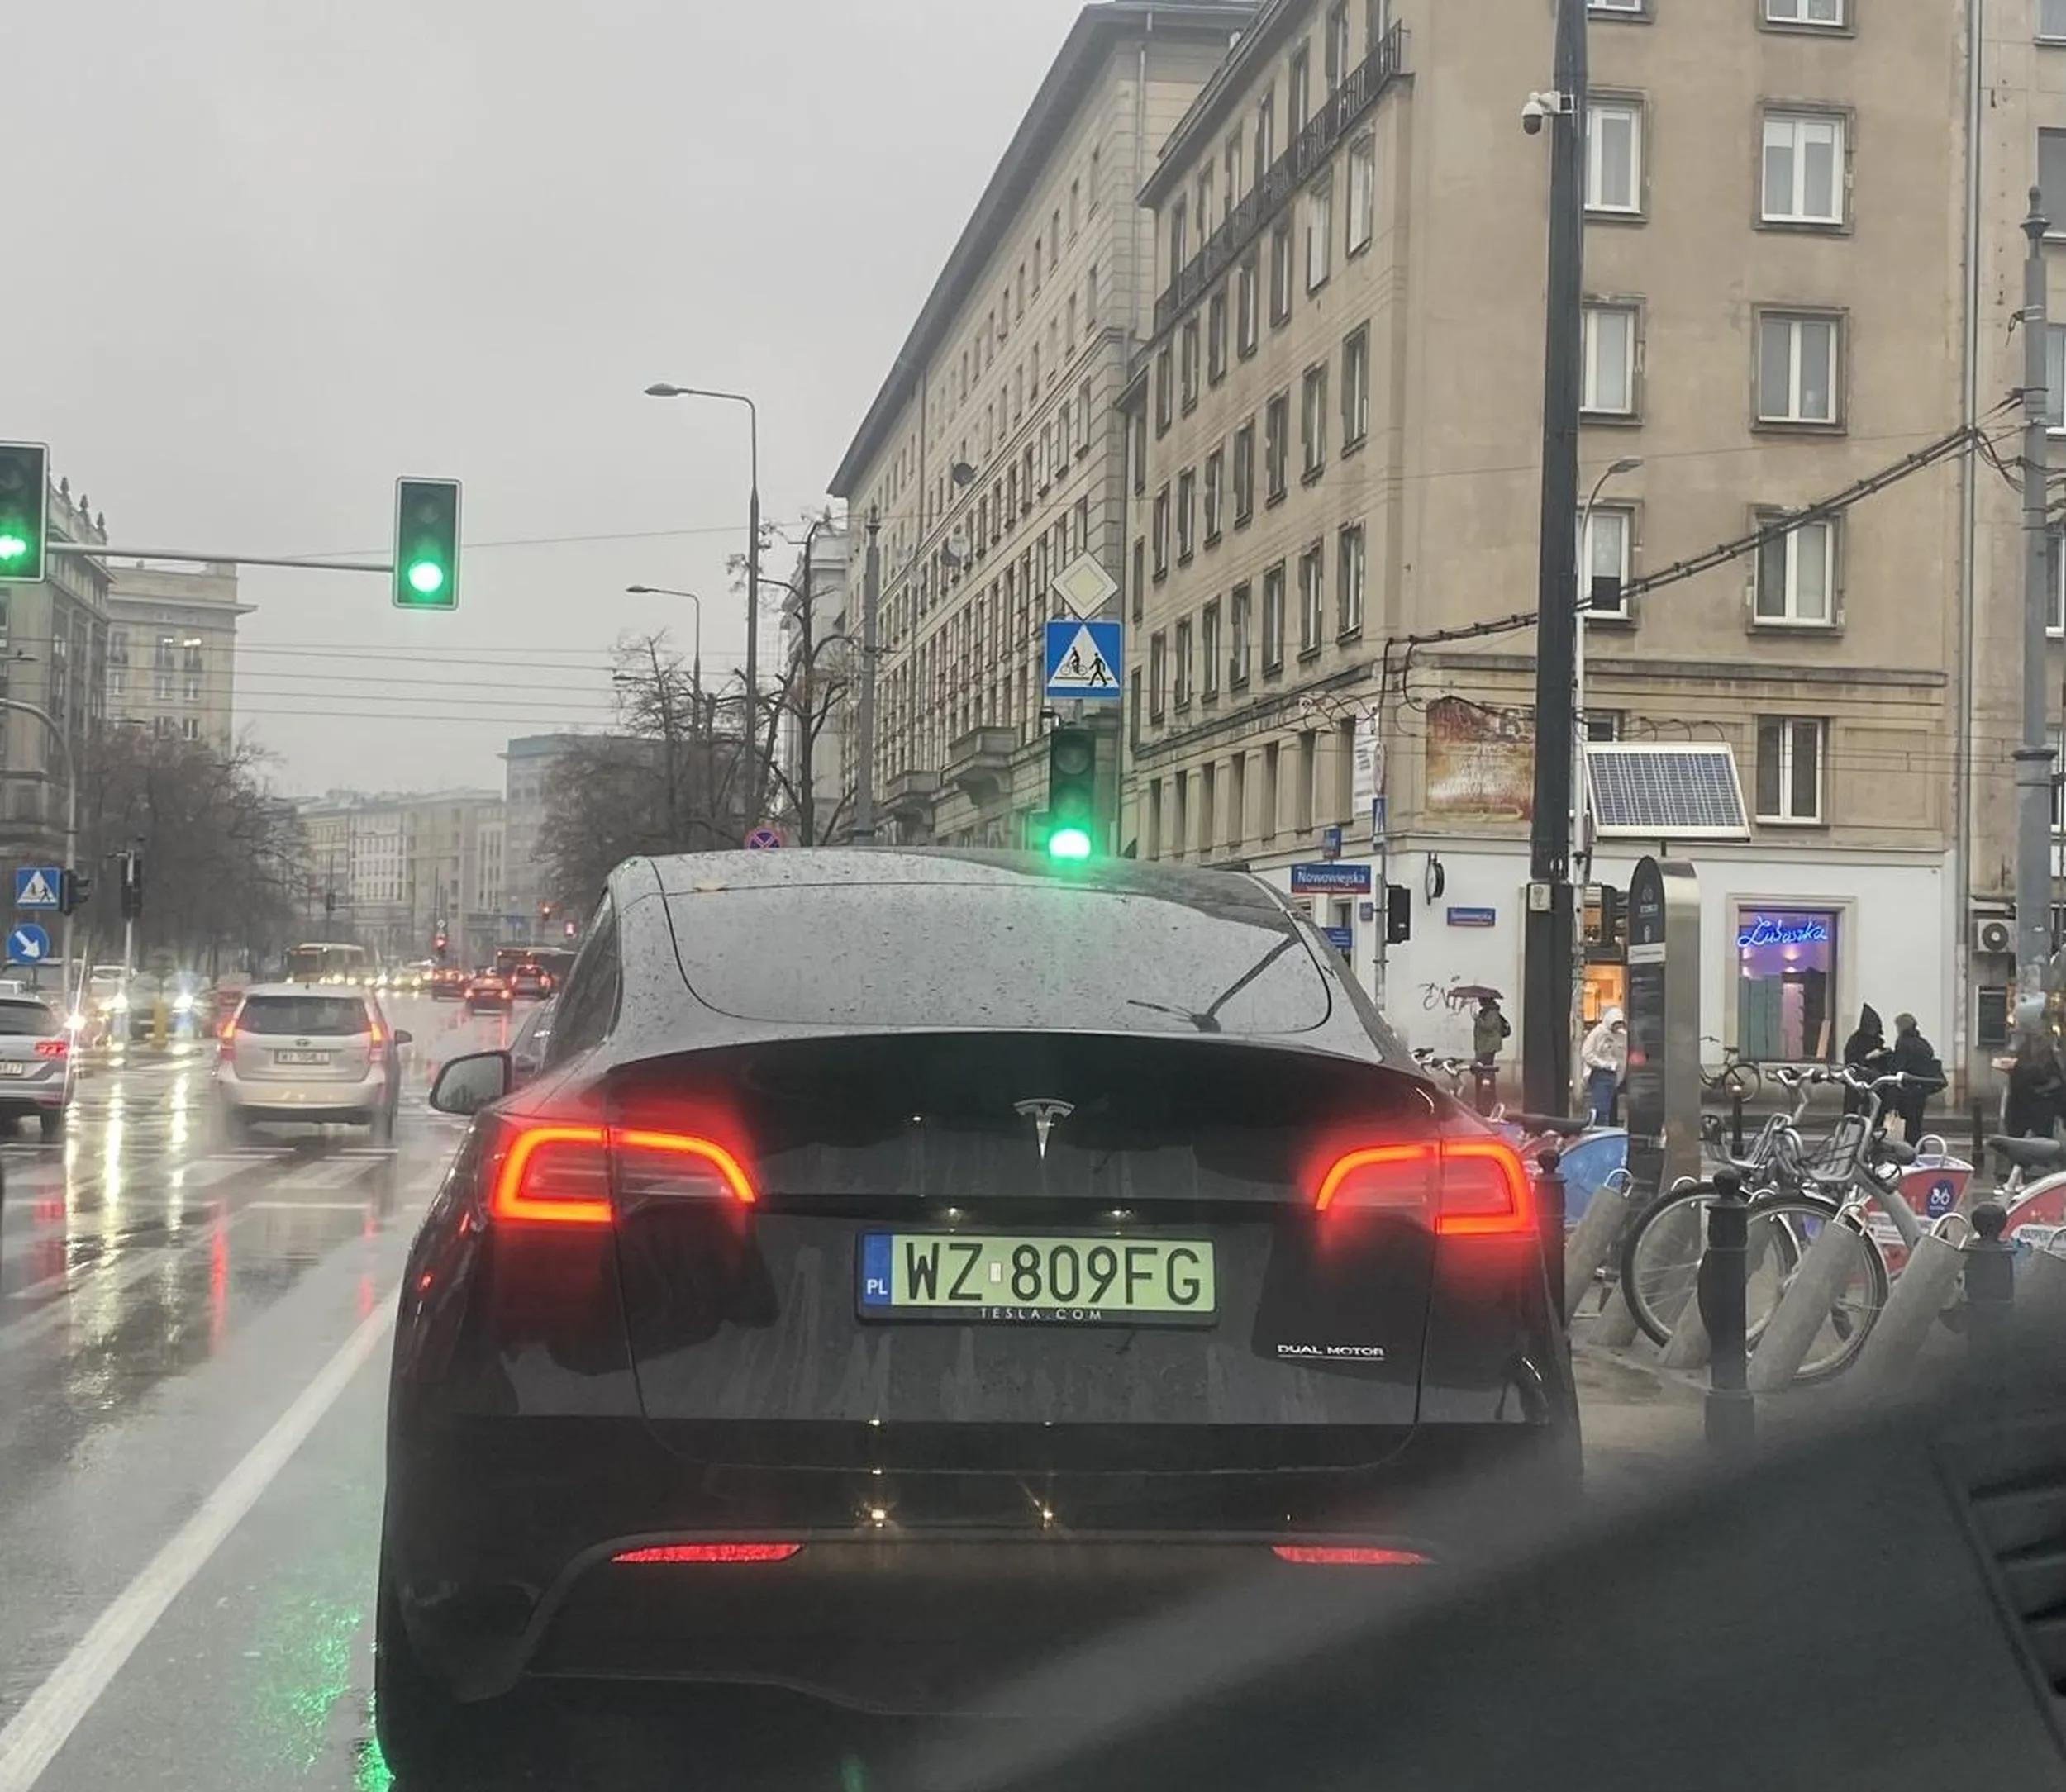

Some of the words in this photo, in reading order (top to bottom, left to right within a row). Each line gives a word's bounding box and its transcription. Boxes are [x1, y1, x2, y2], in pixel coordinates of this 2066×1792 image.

[1297, 870, 1366, 887] Nowowiejska
[906, 1242, 983, 1302] WZ
[1011, 1243, 1201, 1305] 809FG
[866, 1279, 888, 1296] PL
[980, 1307, 1102, 1320] TESLA.COM
[1277, 1344, 1323, 1355] DUAL
[1326, 1346, 1384, 1356] MOTOR
